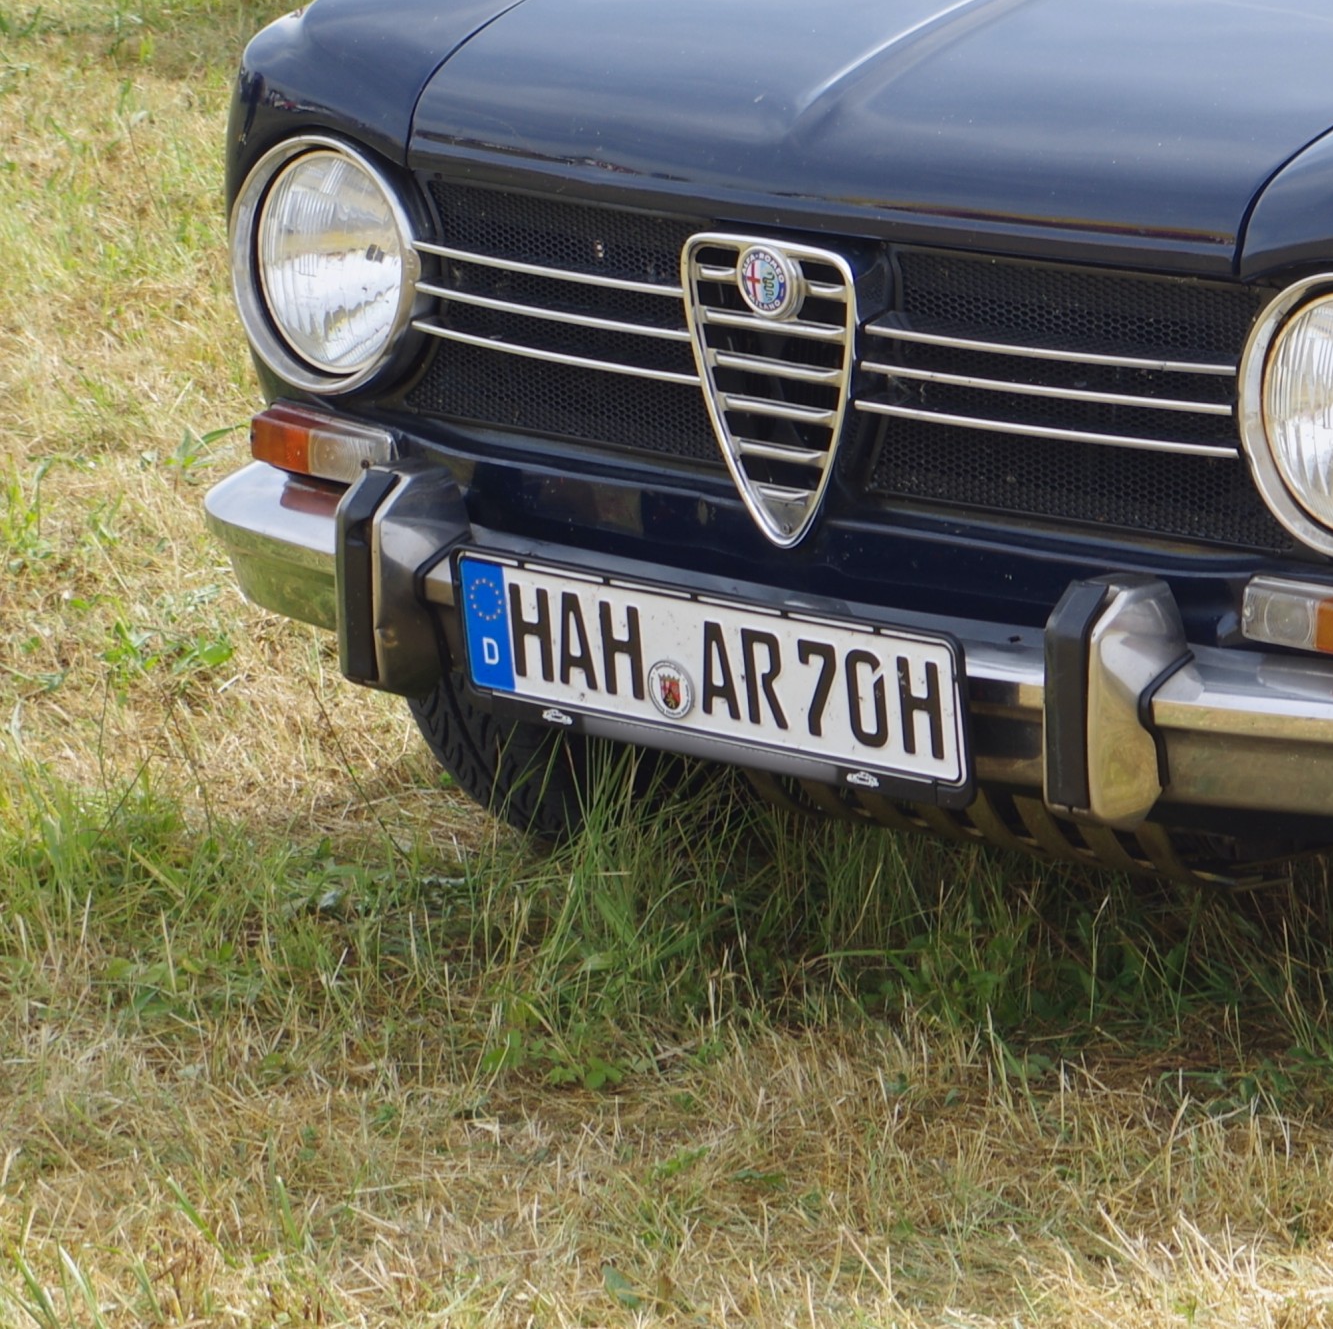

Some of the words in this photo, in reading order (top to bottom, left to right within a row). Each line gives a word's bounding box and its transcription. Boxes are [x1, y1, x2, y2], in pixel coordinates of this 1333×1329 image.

[748, 294, 781, 311] MILANO
[482, 636, 500, 665] D
[508, 582, 646, 701] HAH
